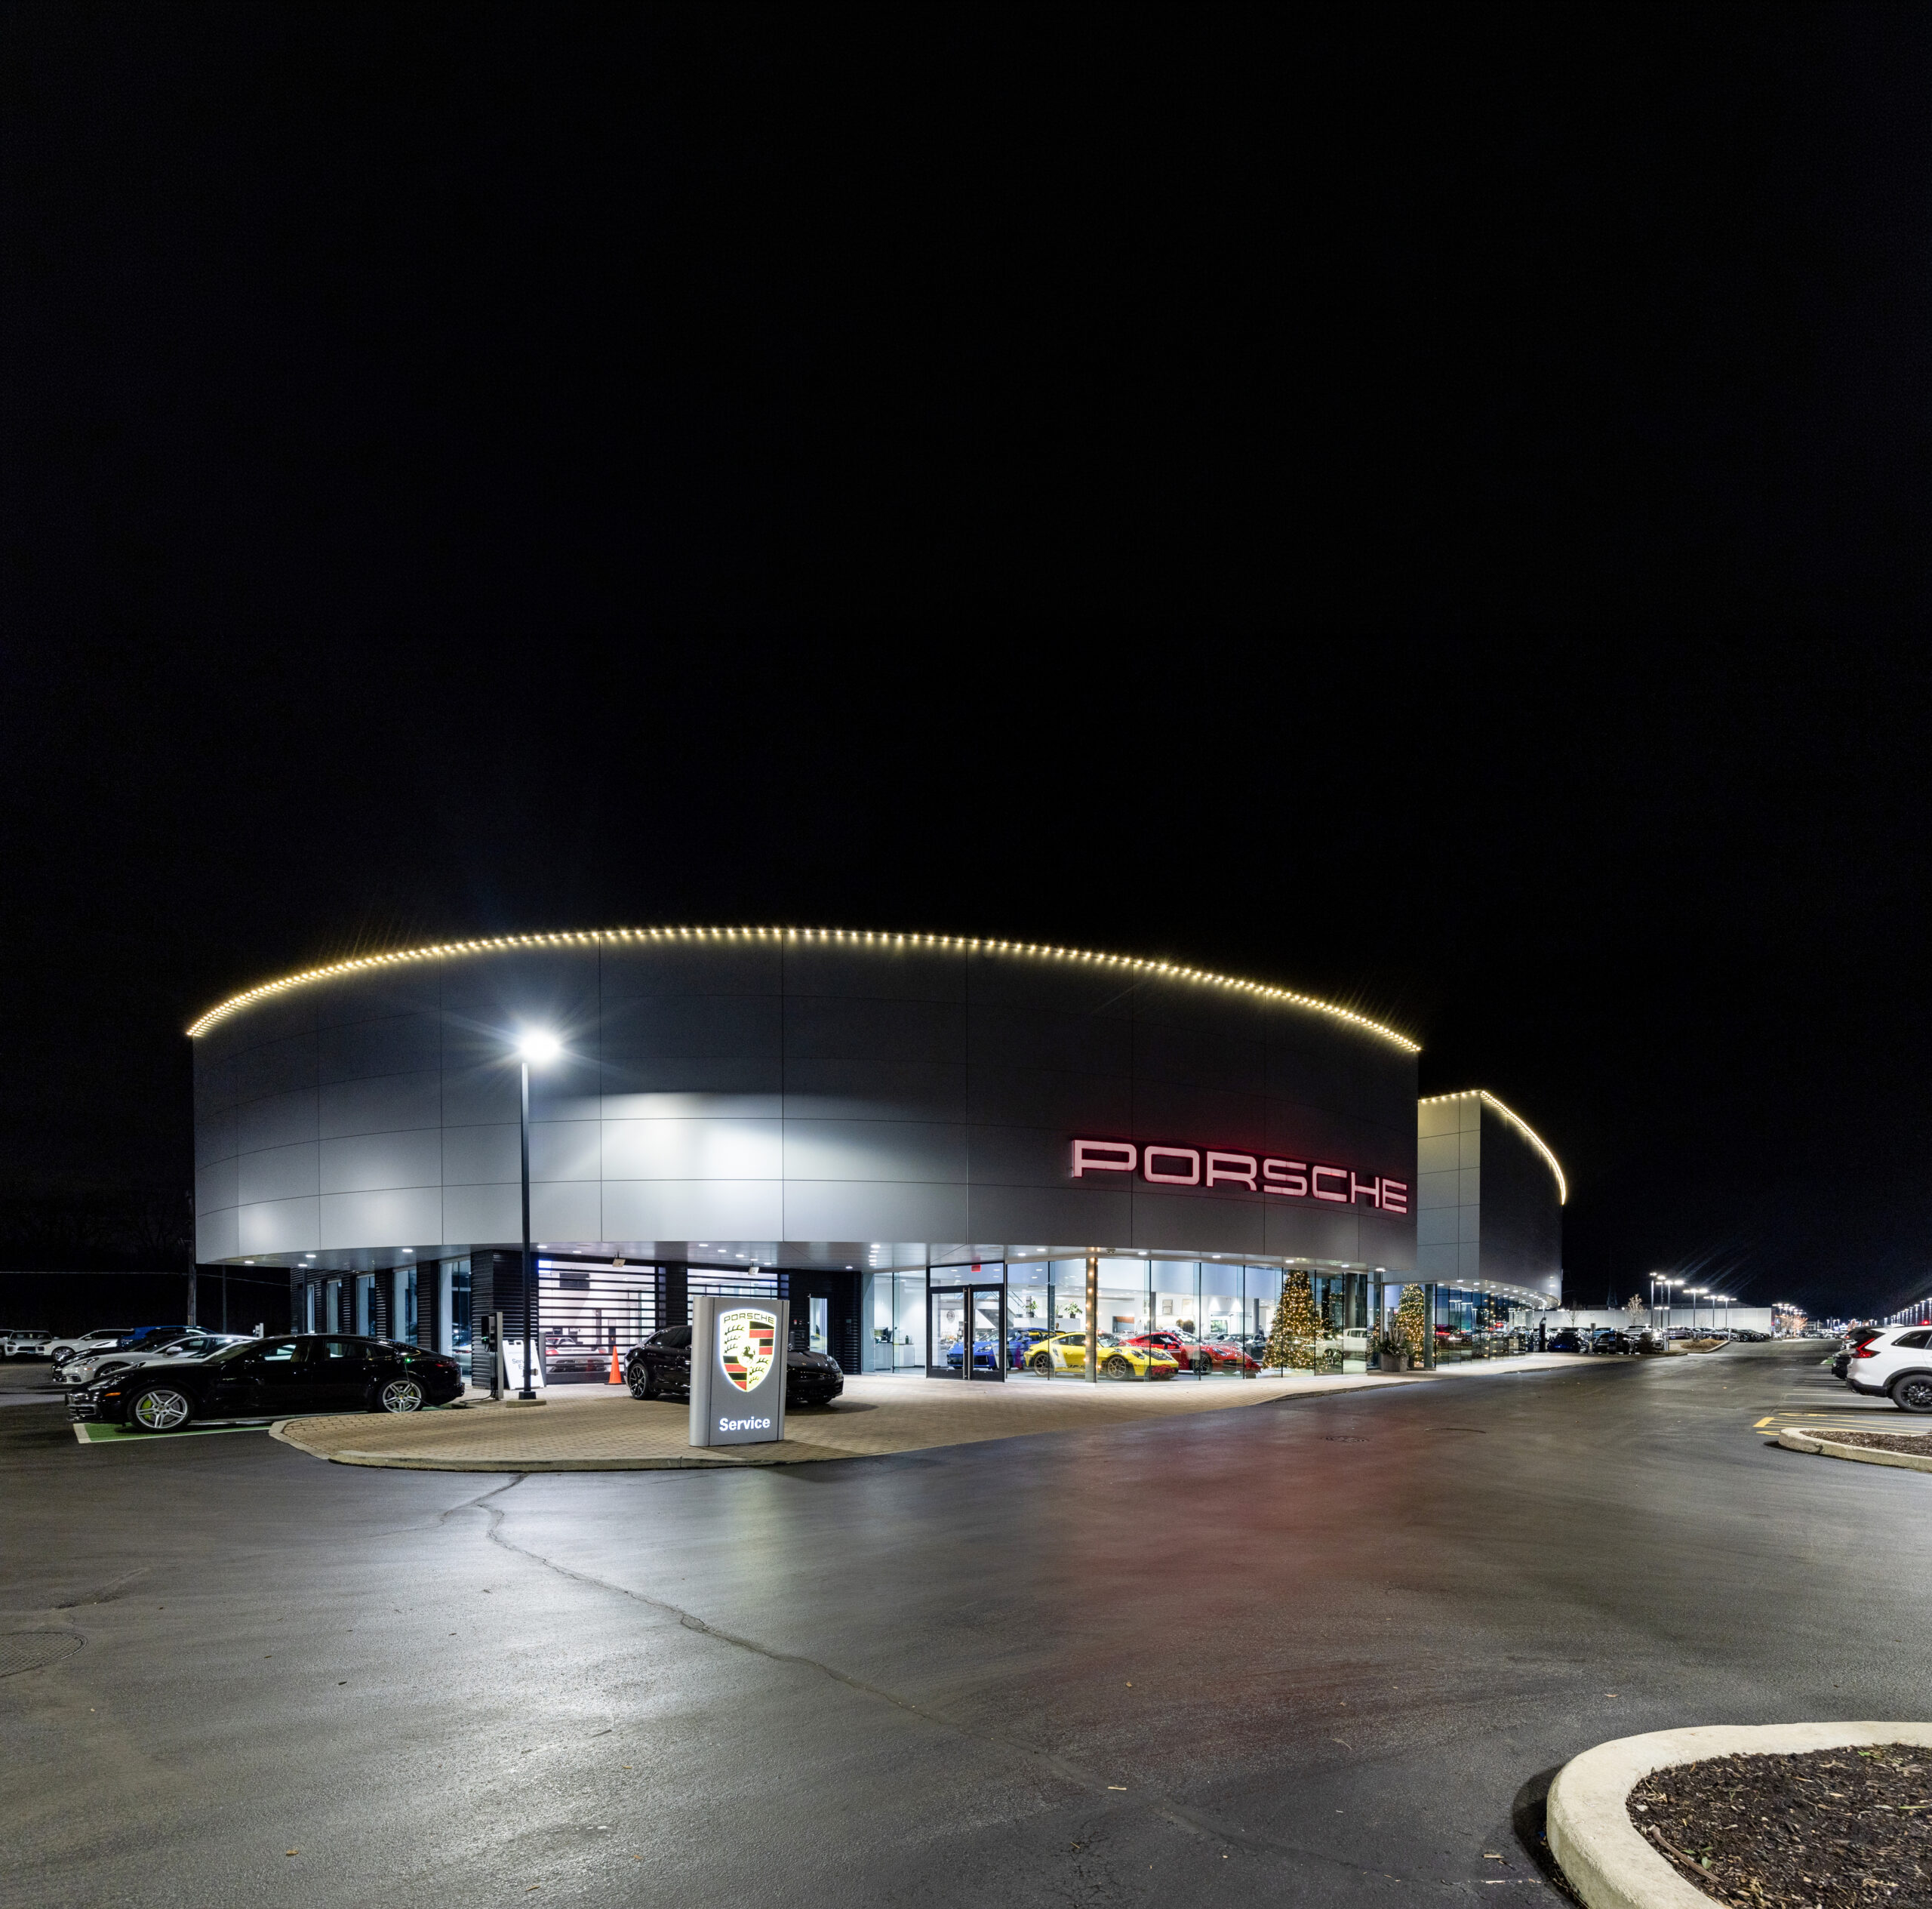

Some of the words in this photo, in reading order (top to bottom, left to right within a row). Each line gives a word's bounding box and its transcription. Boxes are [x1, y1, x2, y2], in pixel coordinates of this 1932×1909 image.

[1072, 1139, 1407, 1214] PORSCHE
[724, 1313, 774, 1324] PORSCHE
[719, 1416, 771, 1431] Service
